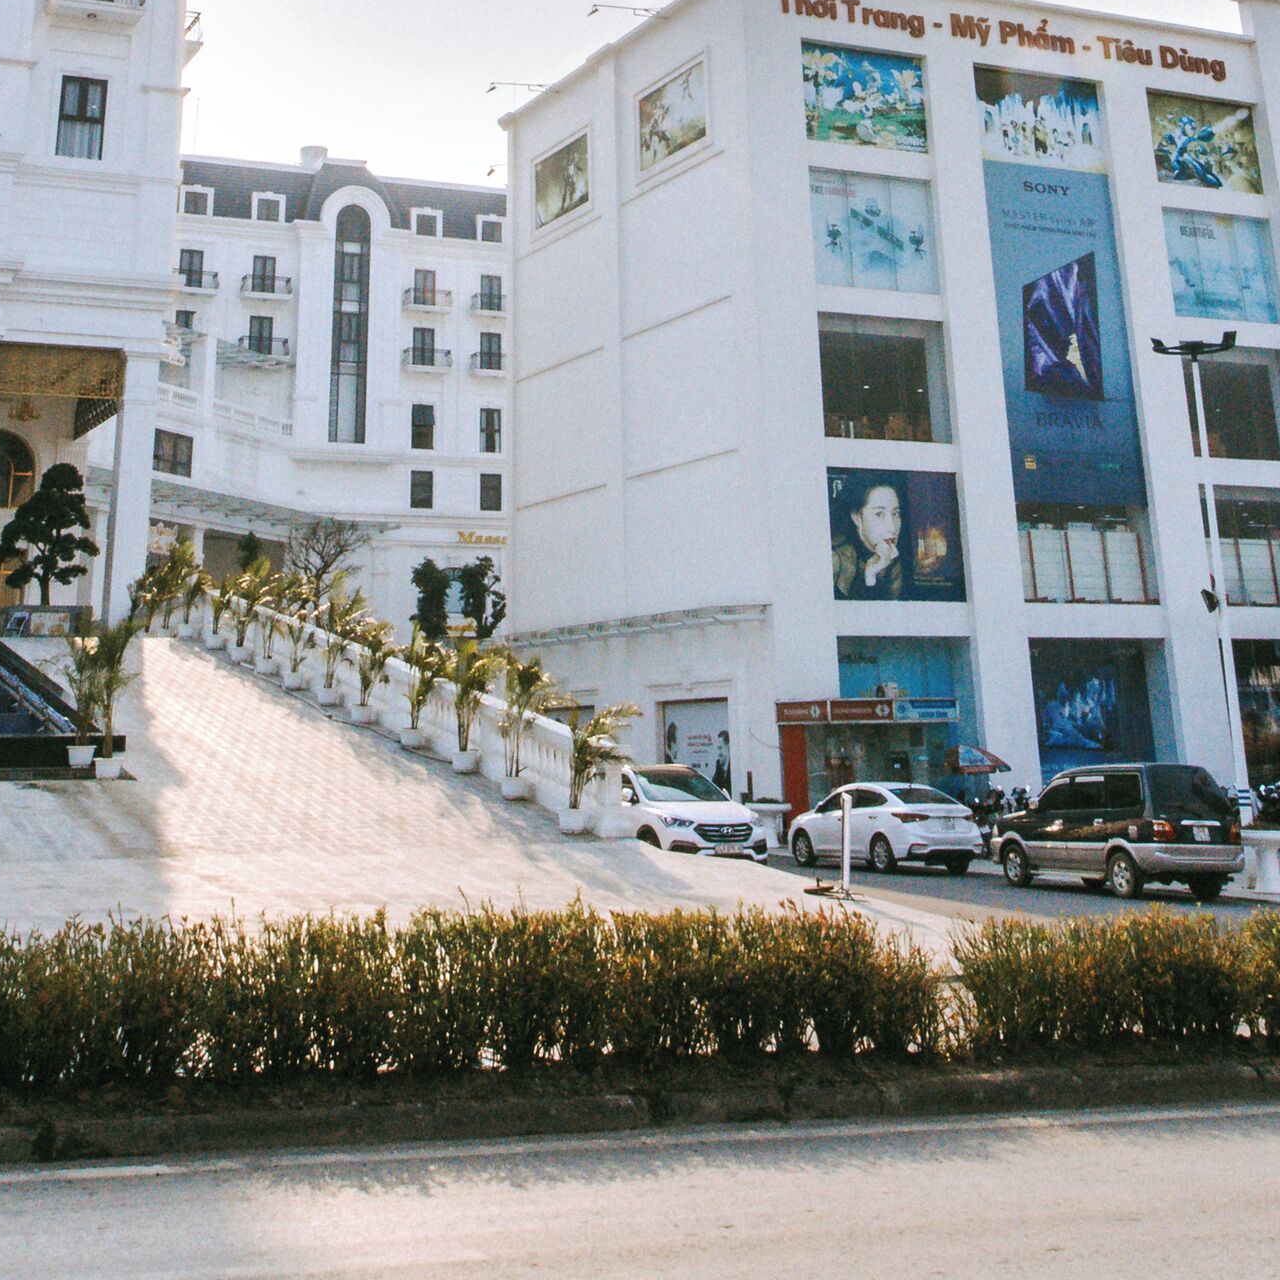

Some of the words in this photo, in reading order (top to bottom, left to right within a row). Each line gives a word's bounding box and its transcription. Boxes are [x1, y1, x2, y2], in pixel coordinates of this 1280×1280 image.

[950, 13, 992, 47] Mỹ
[999, 18, 1076, 55] Phẩm
[1096, 35, 1154, 66] Tiêu
[1159, 45, 1227, 82] Dùng
[1023, 181, 1070, 196] SONY
[1035, 412, 1103, 429] BRAVIA
